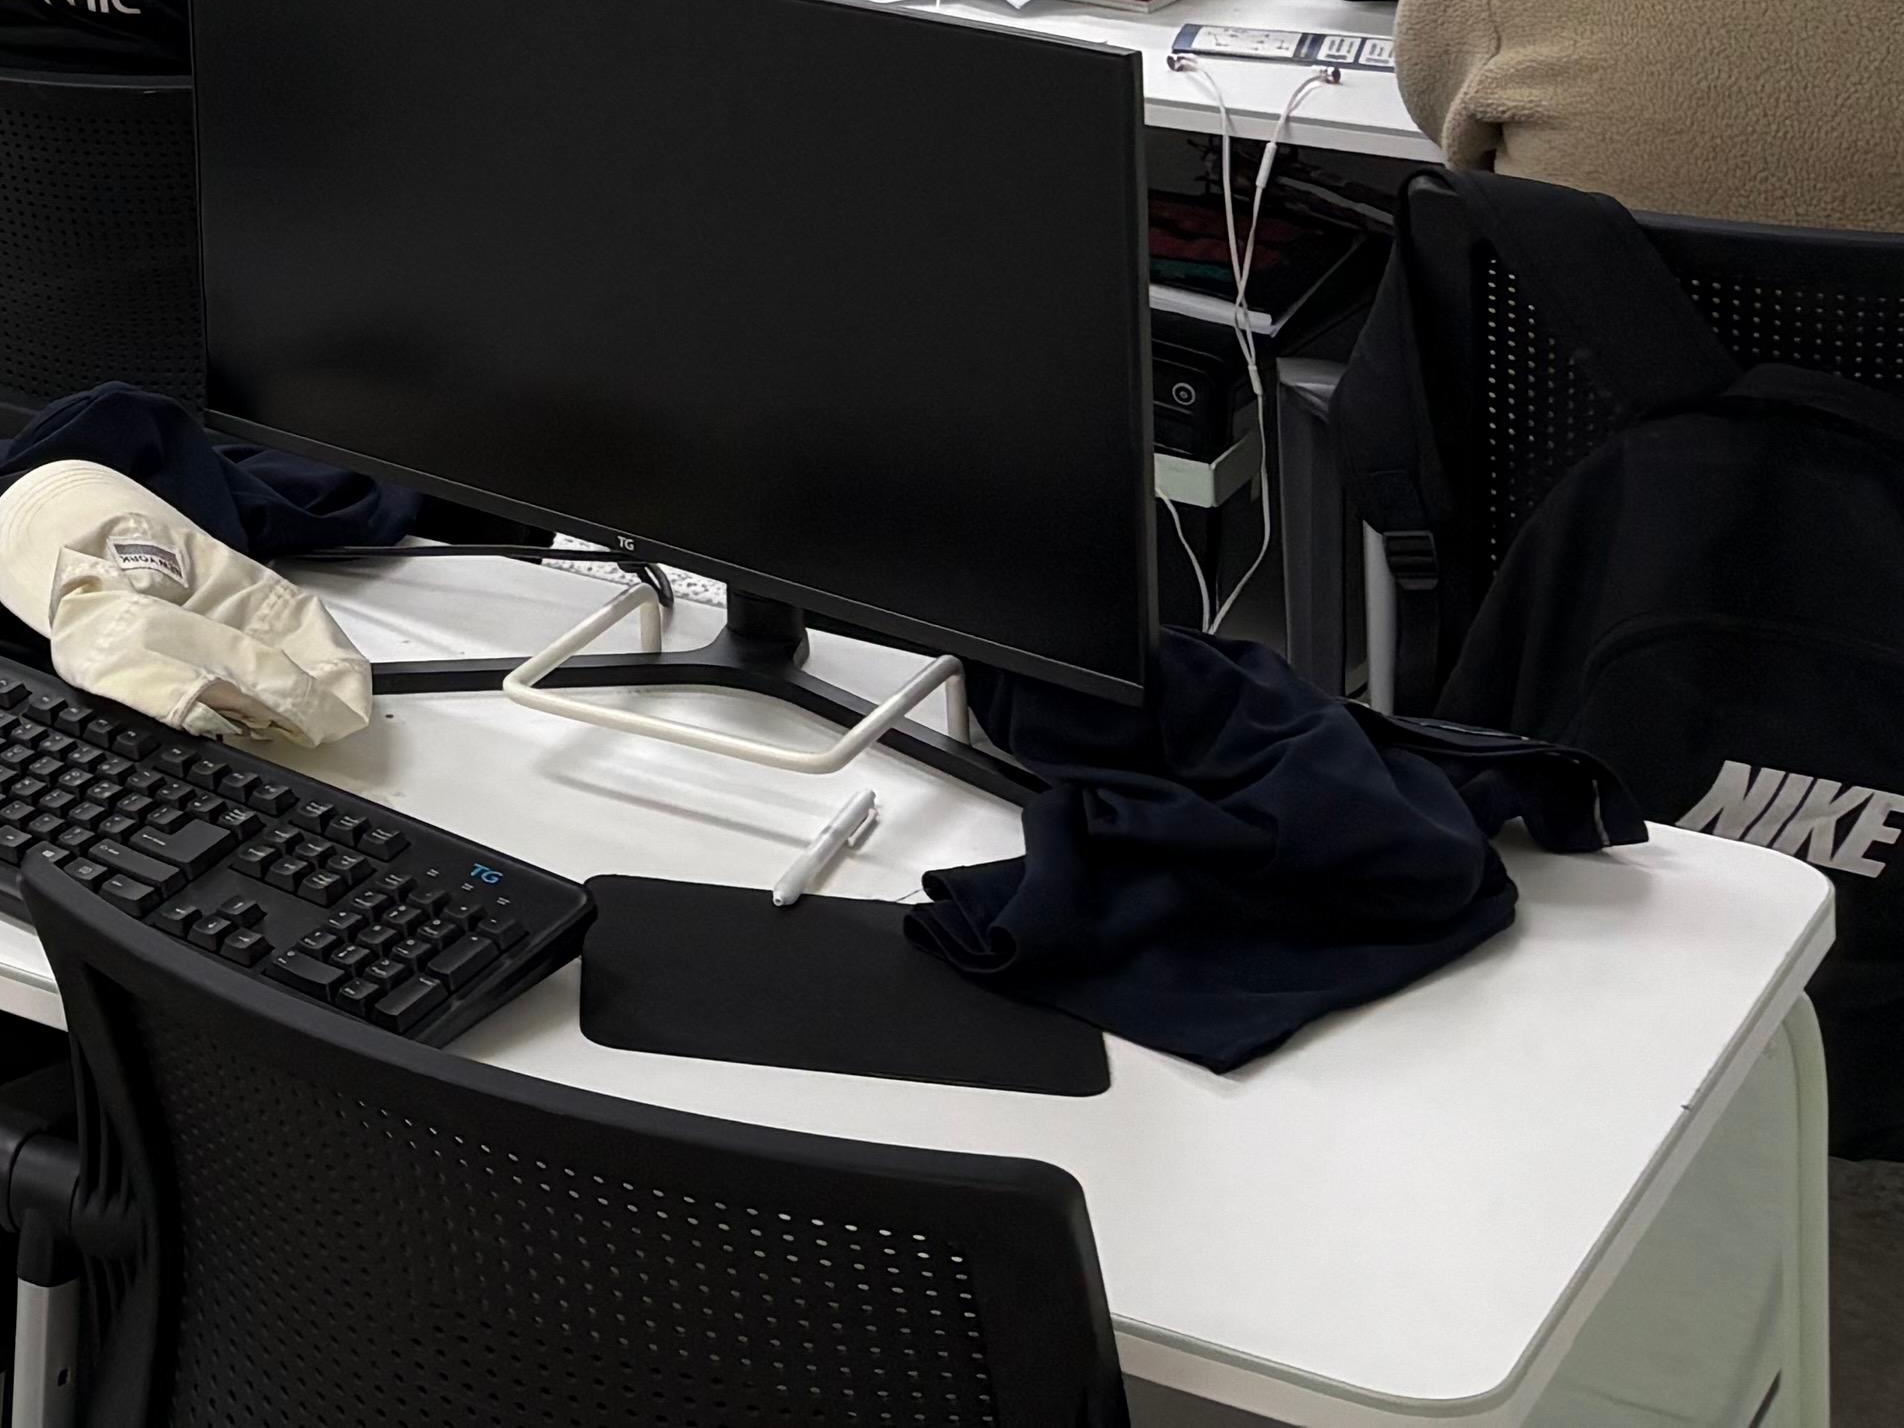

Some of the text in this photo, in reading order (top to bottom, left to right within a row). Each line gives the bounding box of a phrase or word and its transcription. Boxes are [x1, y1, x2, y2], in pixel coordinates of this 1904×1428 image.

[617, 535, 635, 551] TG
[1674, 760, 1904, 879] NIKE
[469, 862, 504, 885] TG
